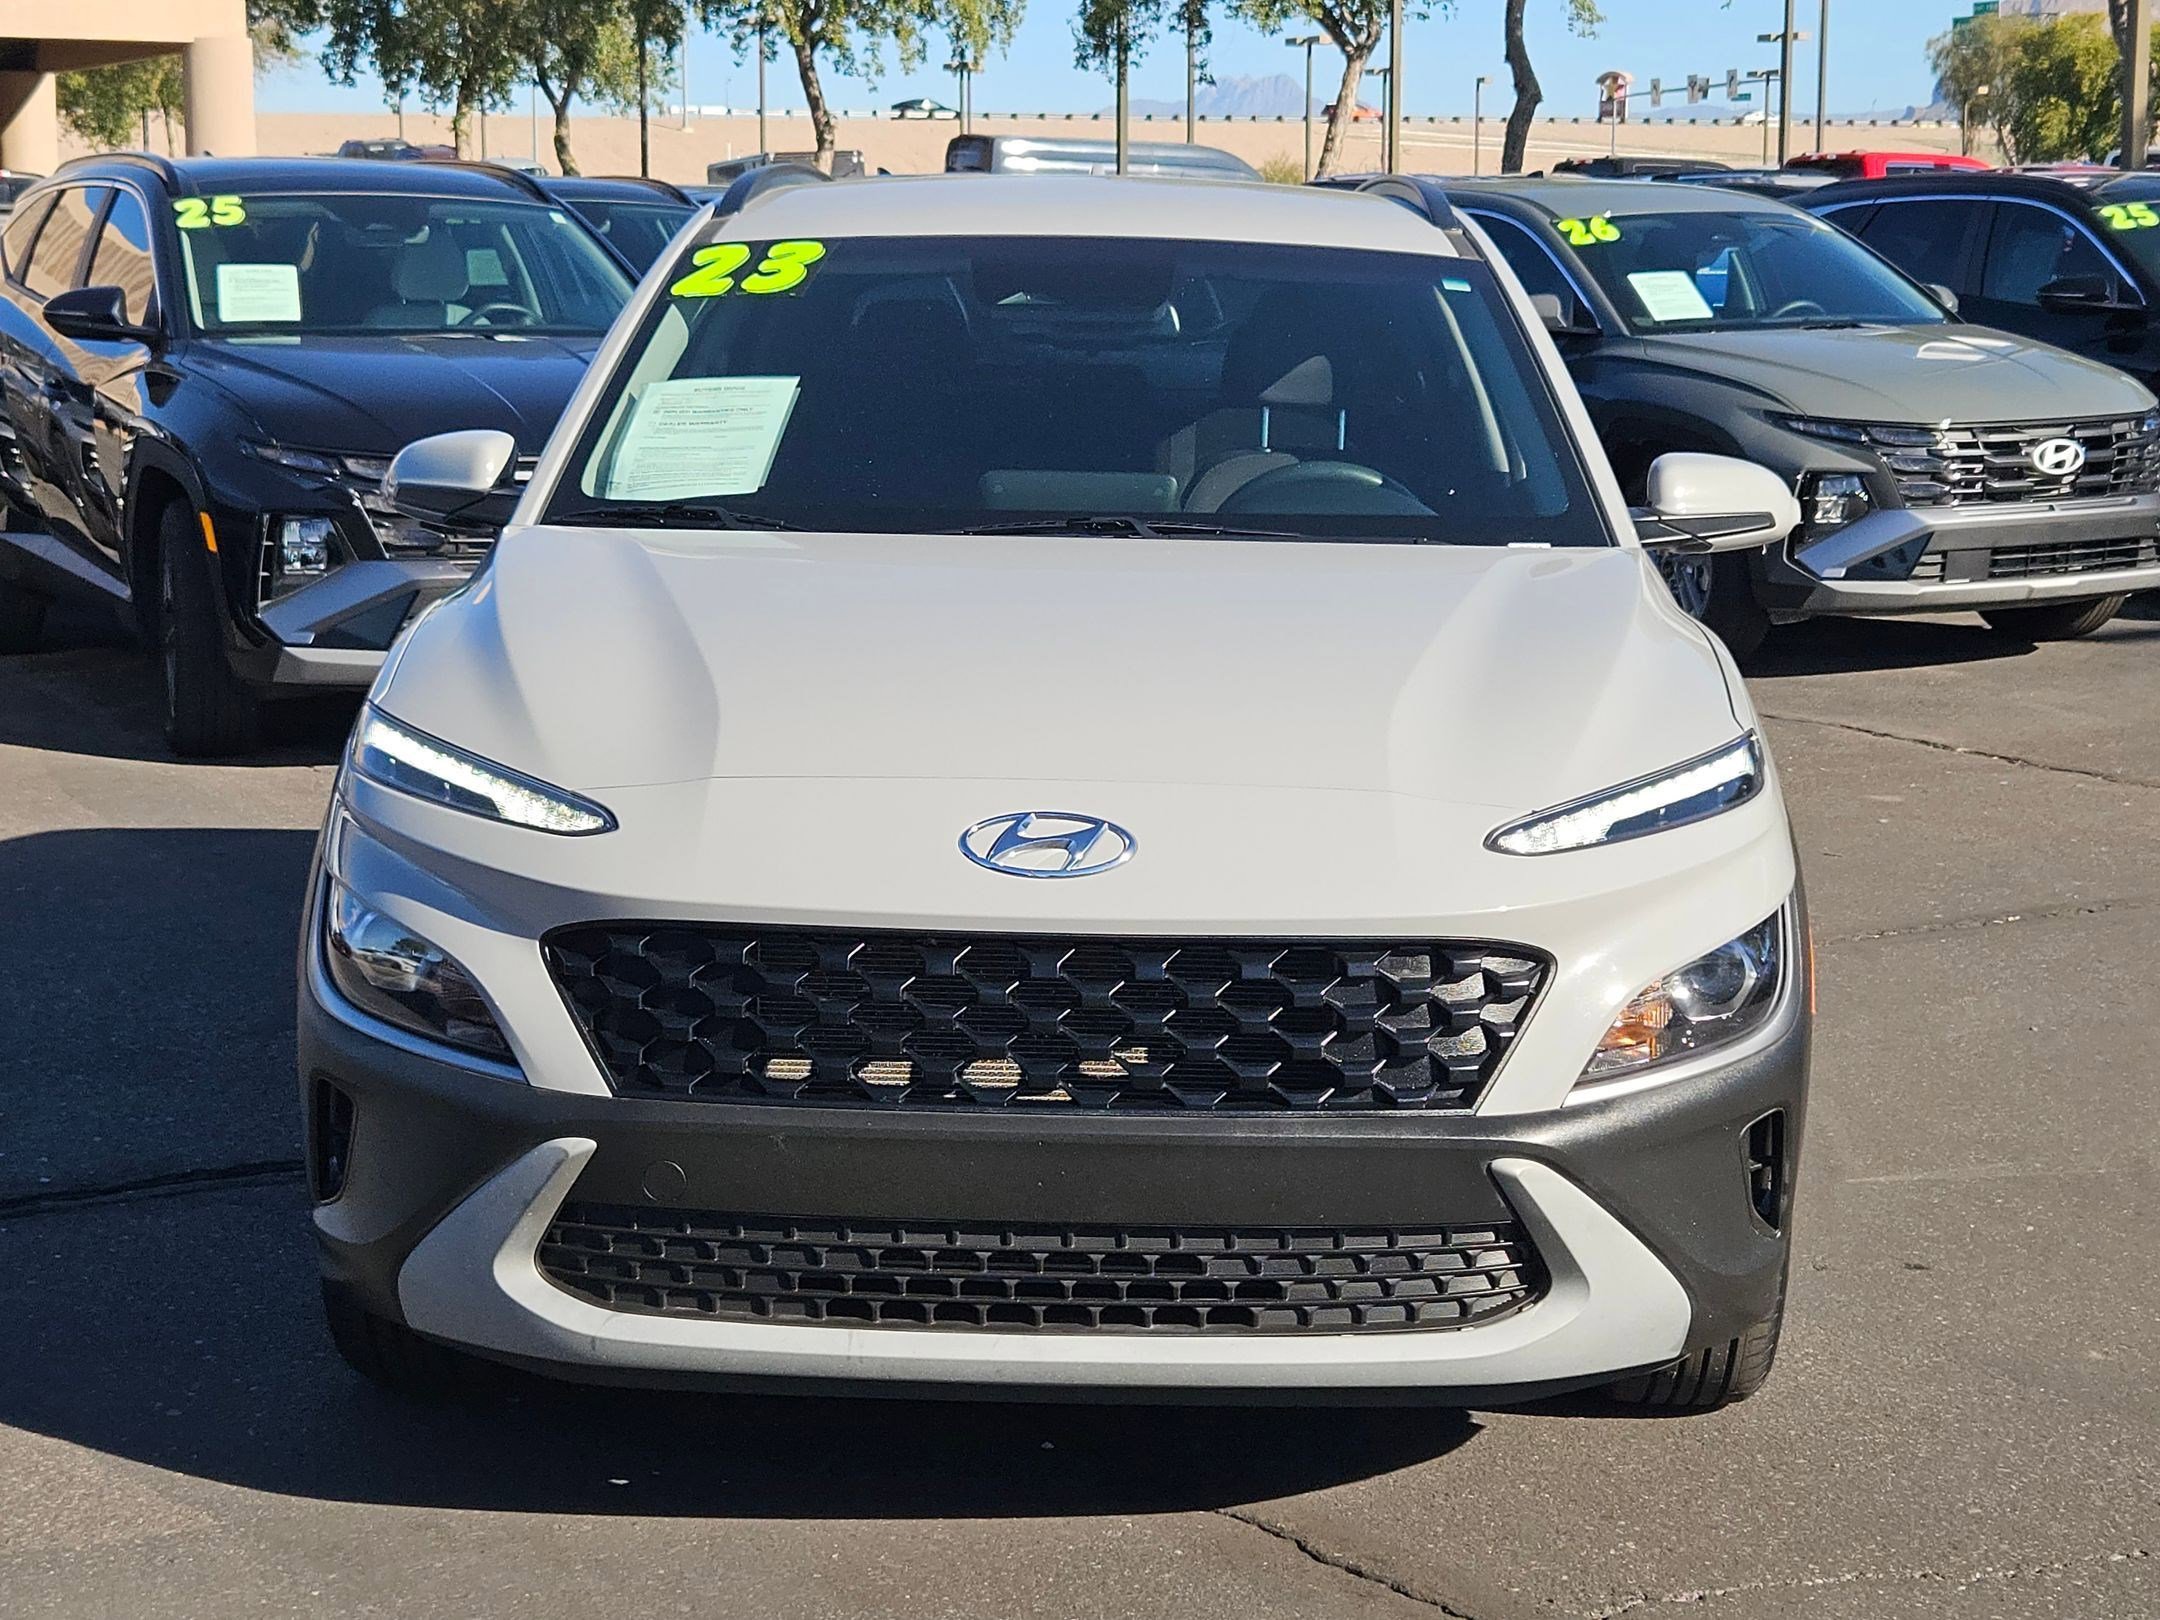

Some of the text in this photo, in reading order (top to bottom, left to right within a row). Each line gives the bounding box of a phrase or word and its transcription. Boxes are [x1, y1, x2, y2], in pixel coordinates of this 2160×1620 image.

[172, 195, 246, 229] 25
[2099, 202, 2160, 230] 25
[1557, 215, 1621, 246] 26
[670, 240, 826, 298] 23
